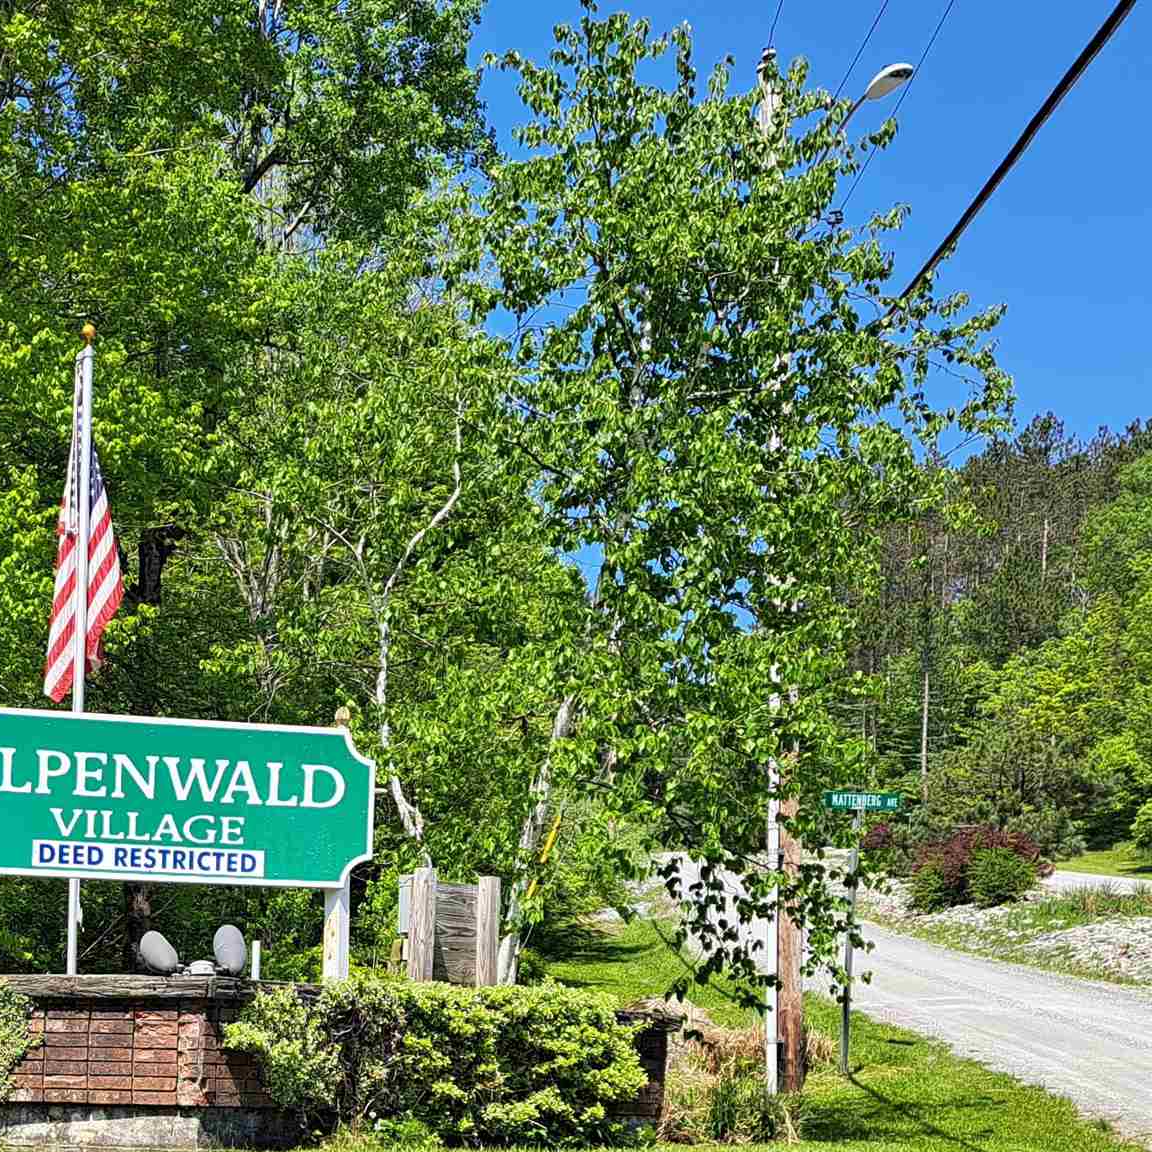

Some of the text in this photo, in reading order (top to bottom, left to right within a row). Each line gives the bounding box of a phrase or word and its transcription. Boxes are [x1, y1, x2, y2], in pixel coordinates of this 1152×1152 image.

[886, 798, 898, 807] AVE
[50, 808, 246, 846] VILLAGE
[38, 844, 257, 873] DEED RESTRICTED
